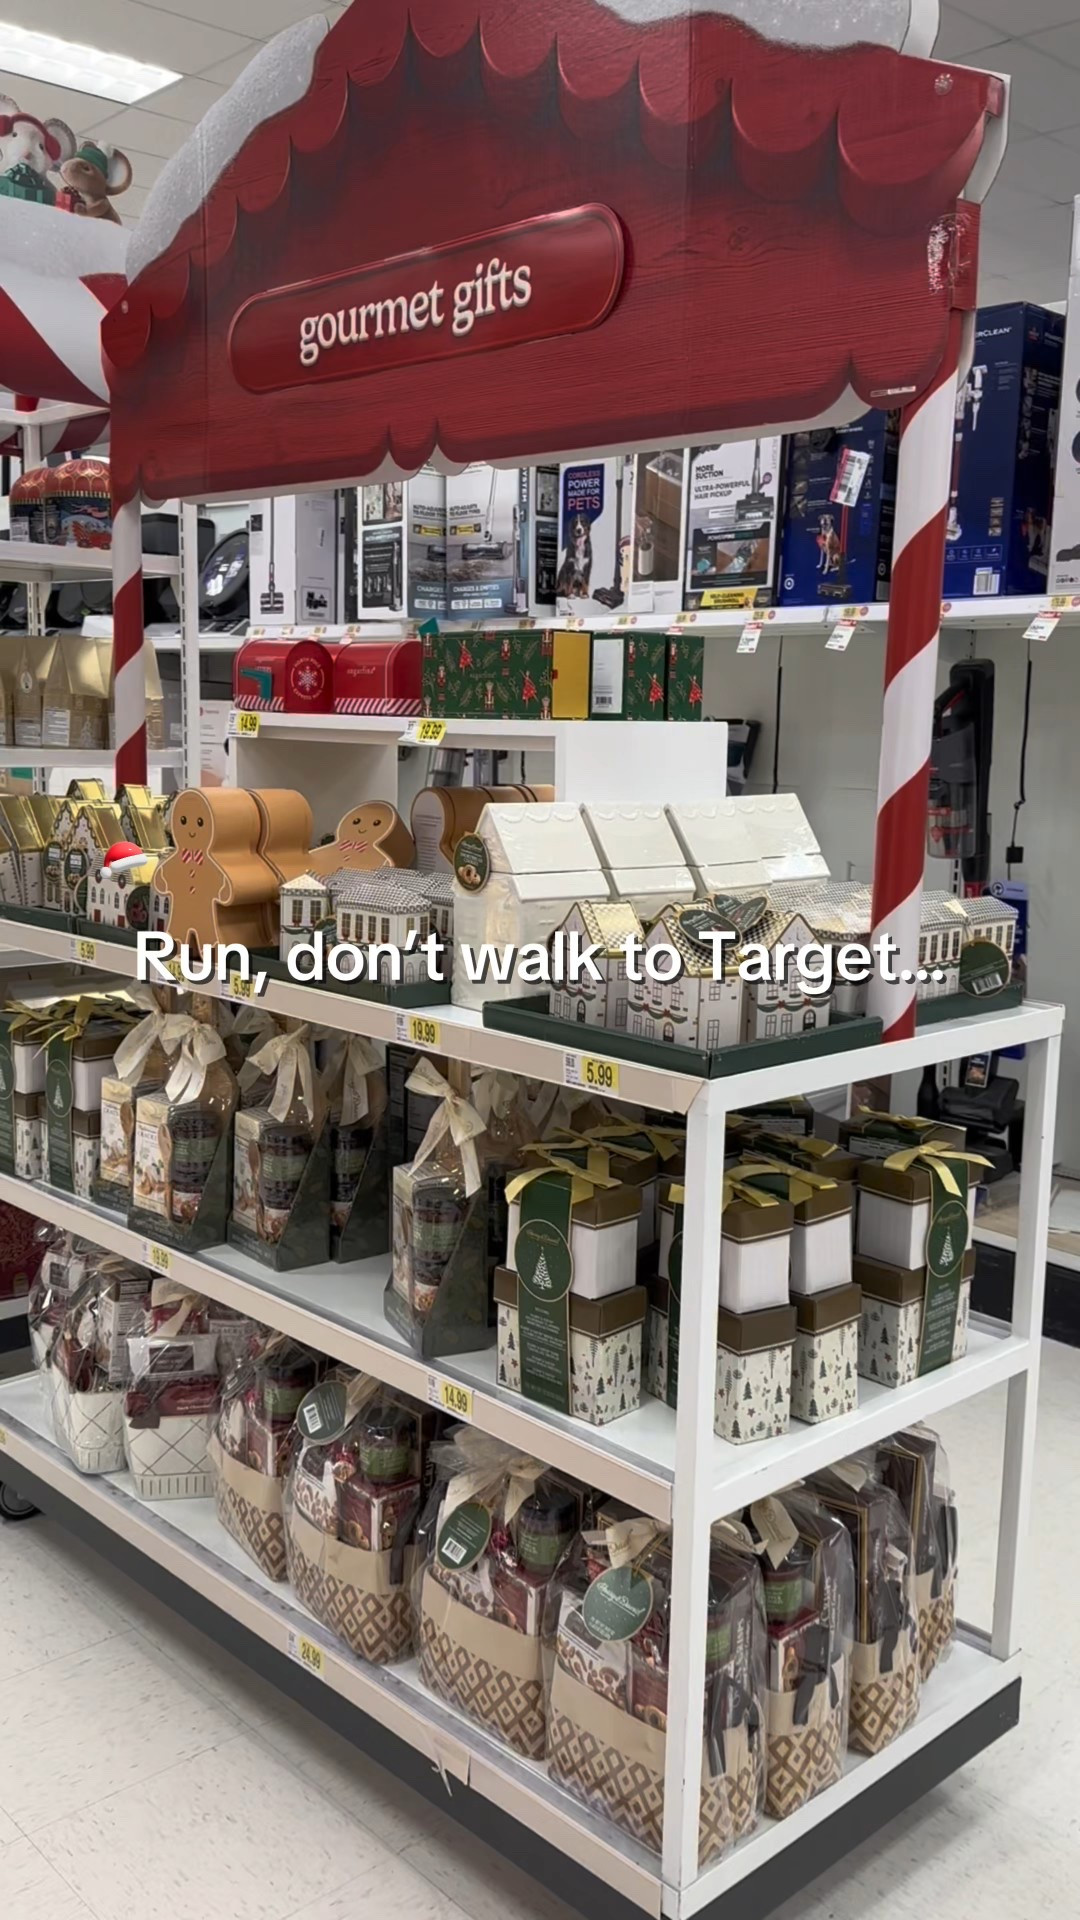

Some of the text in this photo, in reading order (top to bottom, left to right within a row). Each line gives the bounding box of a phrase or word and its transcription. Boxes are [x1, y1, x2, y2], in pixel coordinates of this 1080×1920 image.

[299, 257, 532, 367] gourmet gifts
[695, 464, 714, 473] MORE
[695, 470, 724, 480] SUCTION
[567, 478, 601, 489] POWER
[694, 481, 751, 493] ULTRA-POWERFUL
[567, 487, 601, 497] MADE FOR
[567, 496, 601, 510] PETS
[412, 1019, 436, 1044] 19.99
[586, 1061, 613, 1088] 5.99
[444, 1386, 468, 1412] 14.99
[301, 1642, 321, 1670] 24.99
